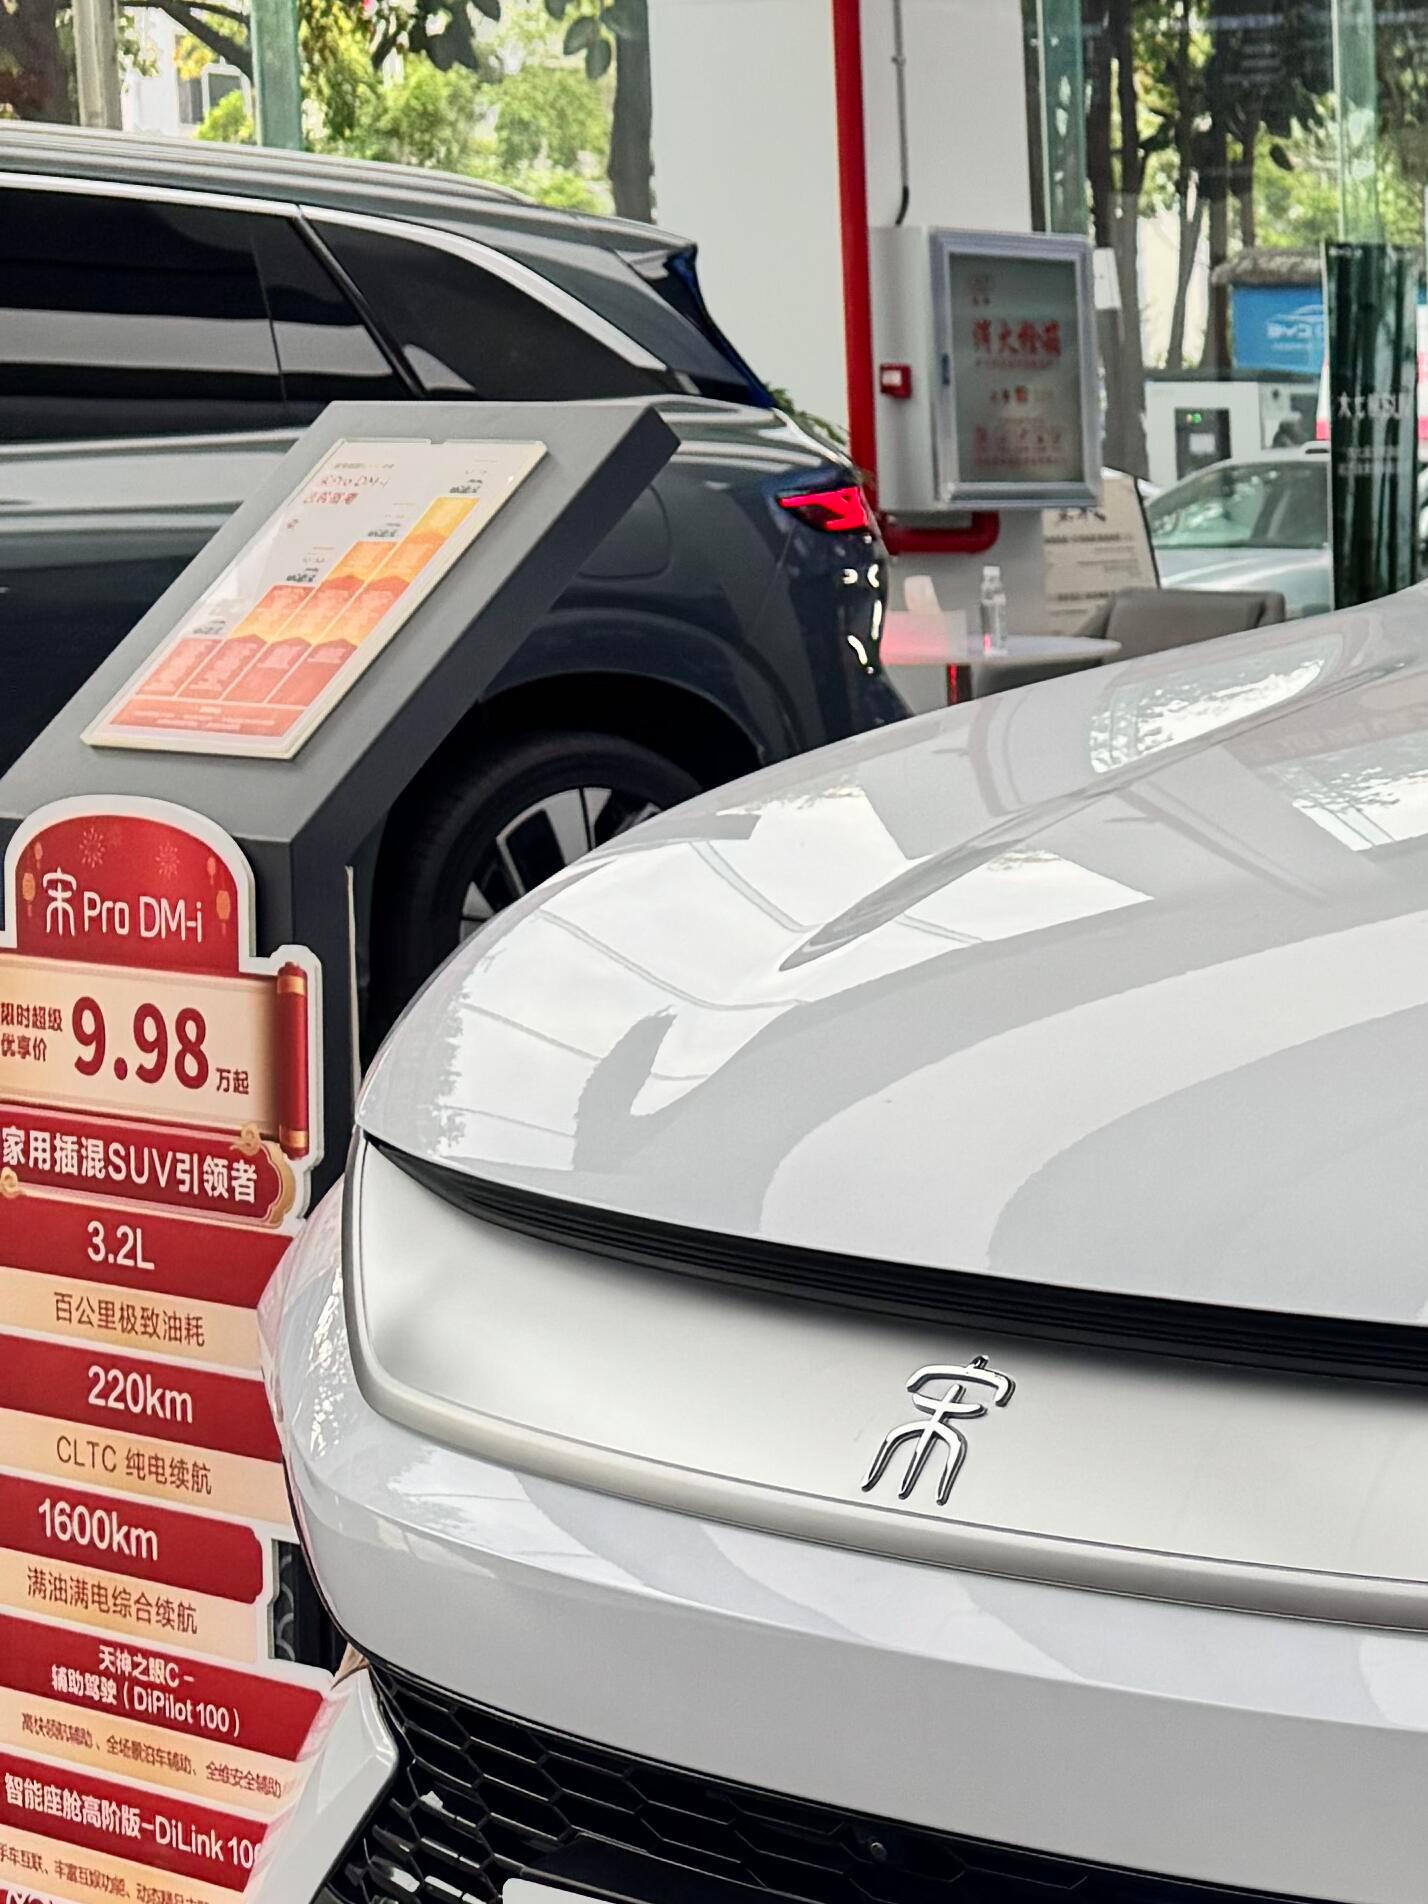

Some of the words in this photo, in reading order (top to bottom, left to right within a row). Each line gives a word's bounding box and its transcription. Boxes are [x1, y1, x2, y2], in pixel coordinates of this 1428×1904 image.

[139, 895, 203, 944] DM-i
[0, 1032, 48, 1063] 优享价
[72, 995, 209, 1090] 9.98
[215, 1067, 250, 1096] 万起
[1, 1125, 258, 1205] 家用插混SUV引领者
[87, 1219, 156, 1271] 3.2L
[53, 1291, 206, 1348] 百公里极致油耗
[88, 1364, 194, 1424] 220km
[56, 1435, 117, 1473] CLTC
[125, 1448, 213, 1496] 纯电续航
[38, 1497, 159, 1561] 1600km
[26, 1566, 199, 1636] 满油满电综合续航
